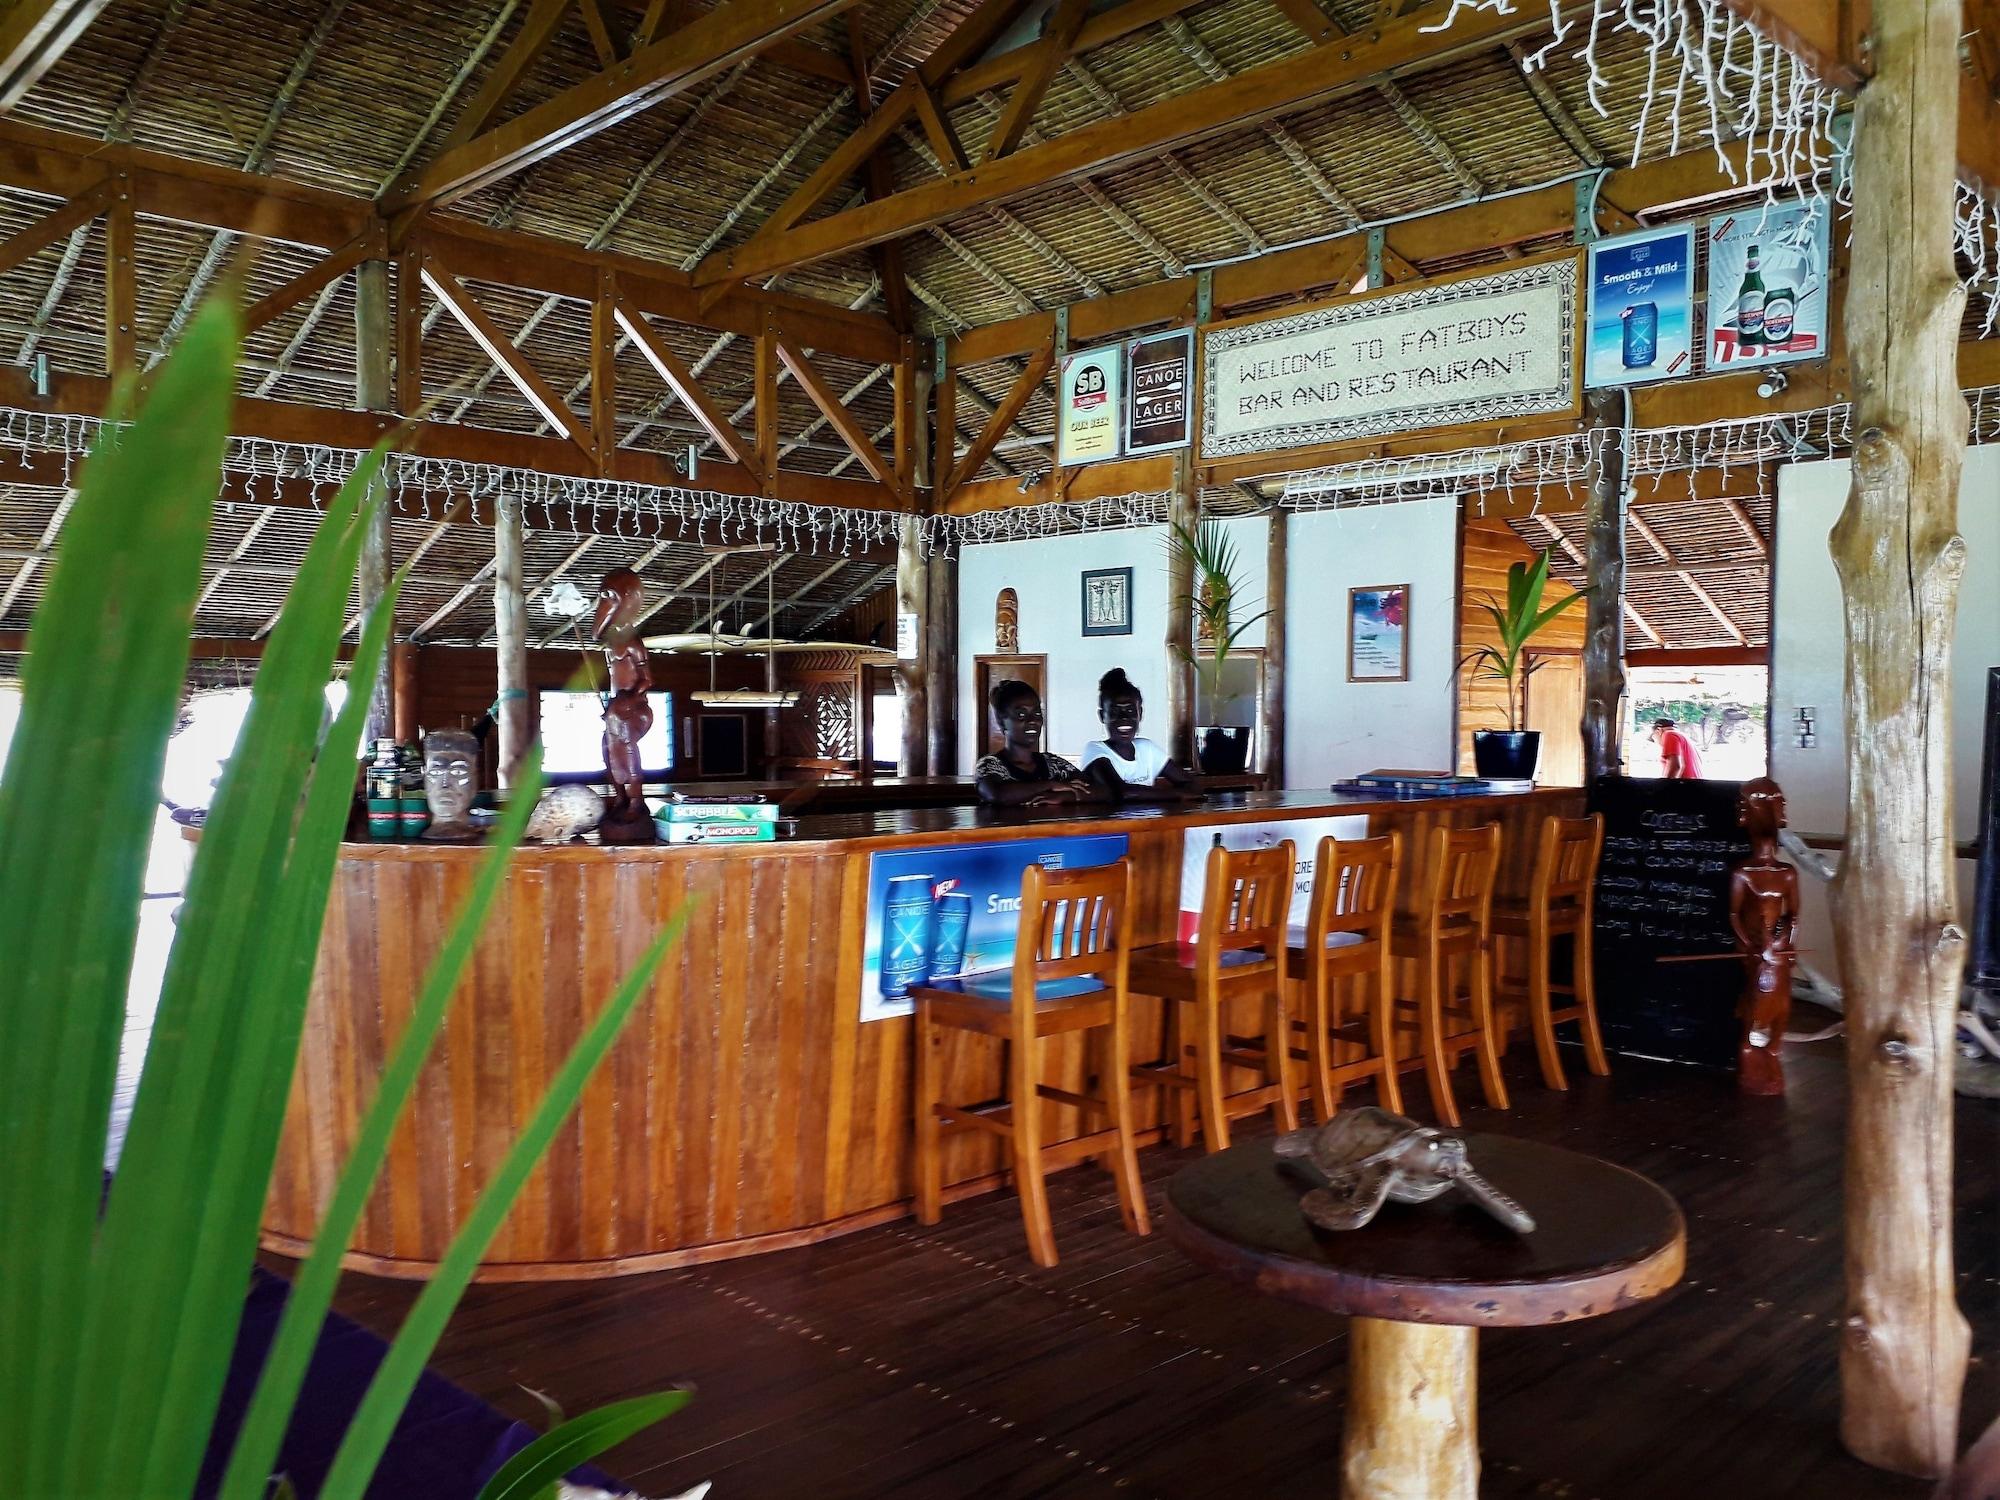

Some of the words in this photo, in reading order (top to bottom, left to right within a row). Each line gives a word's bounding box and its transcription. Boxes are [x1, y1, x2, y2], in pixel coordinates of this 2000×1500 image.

[1603, 269, 1641, 285] Smooth
[1644, 267, 1653, 277] &
[1654, 261, 1678, 275] Mild
[1240, 347, 1337, 384] WELCOME
[1352, 338, 1383, 362] TO
[1401, 312, 1528, 355] FATBOYS
[1076, 370, 1103, 394] SB
[1136, 368, 1183, 387] CANOE
[1239, 390, 1283, 416] BAR
[1292, 381, 1340, 406] AND
[1349, 350, 1532, 399] RESTAURANT
[1135, 400, 1182, 419] LAGER
[707, 827, 758, 836] MONOPOLY
[1294, 860, 1313, 875] ORE
[987, 893, 1022, 914] Smo
